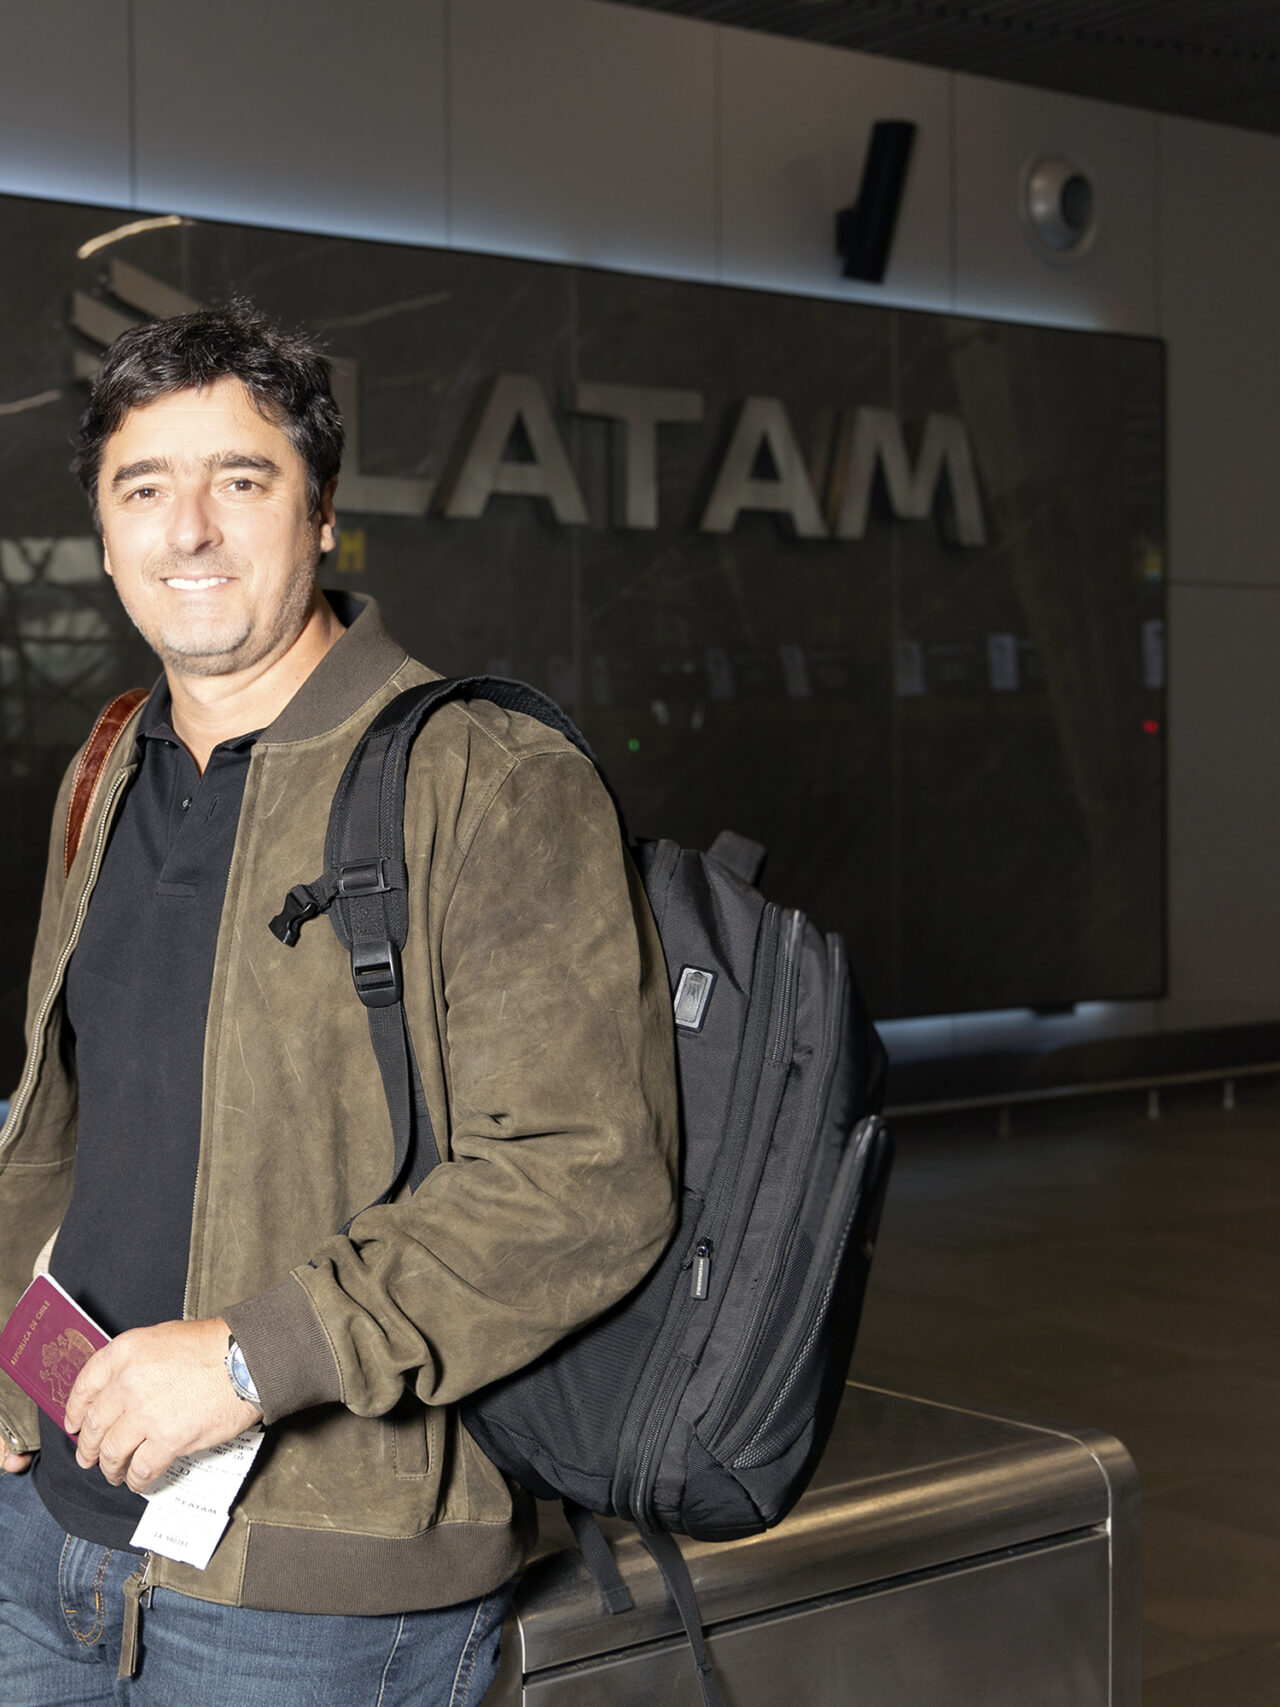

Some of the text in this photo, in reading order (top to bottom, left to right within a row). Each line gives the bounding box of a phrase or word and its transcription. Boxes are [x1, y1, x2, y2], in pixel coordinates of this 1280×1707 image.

[326, 356, 987, 547] LATAM
[10, 1300, 51, 1366] REPUBLICA DE CHILE
